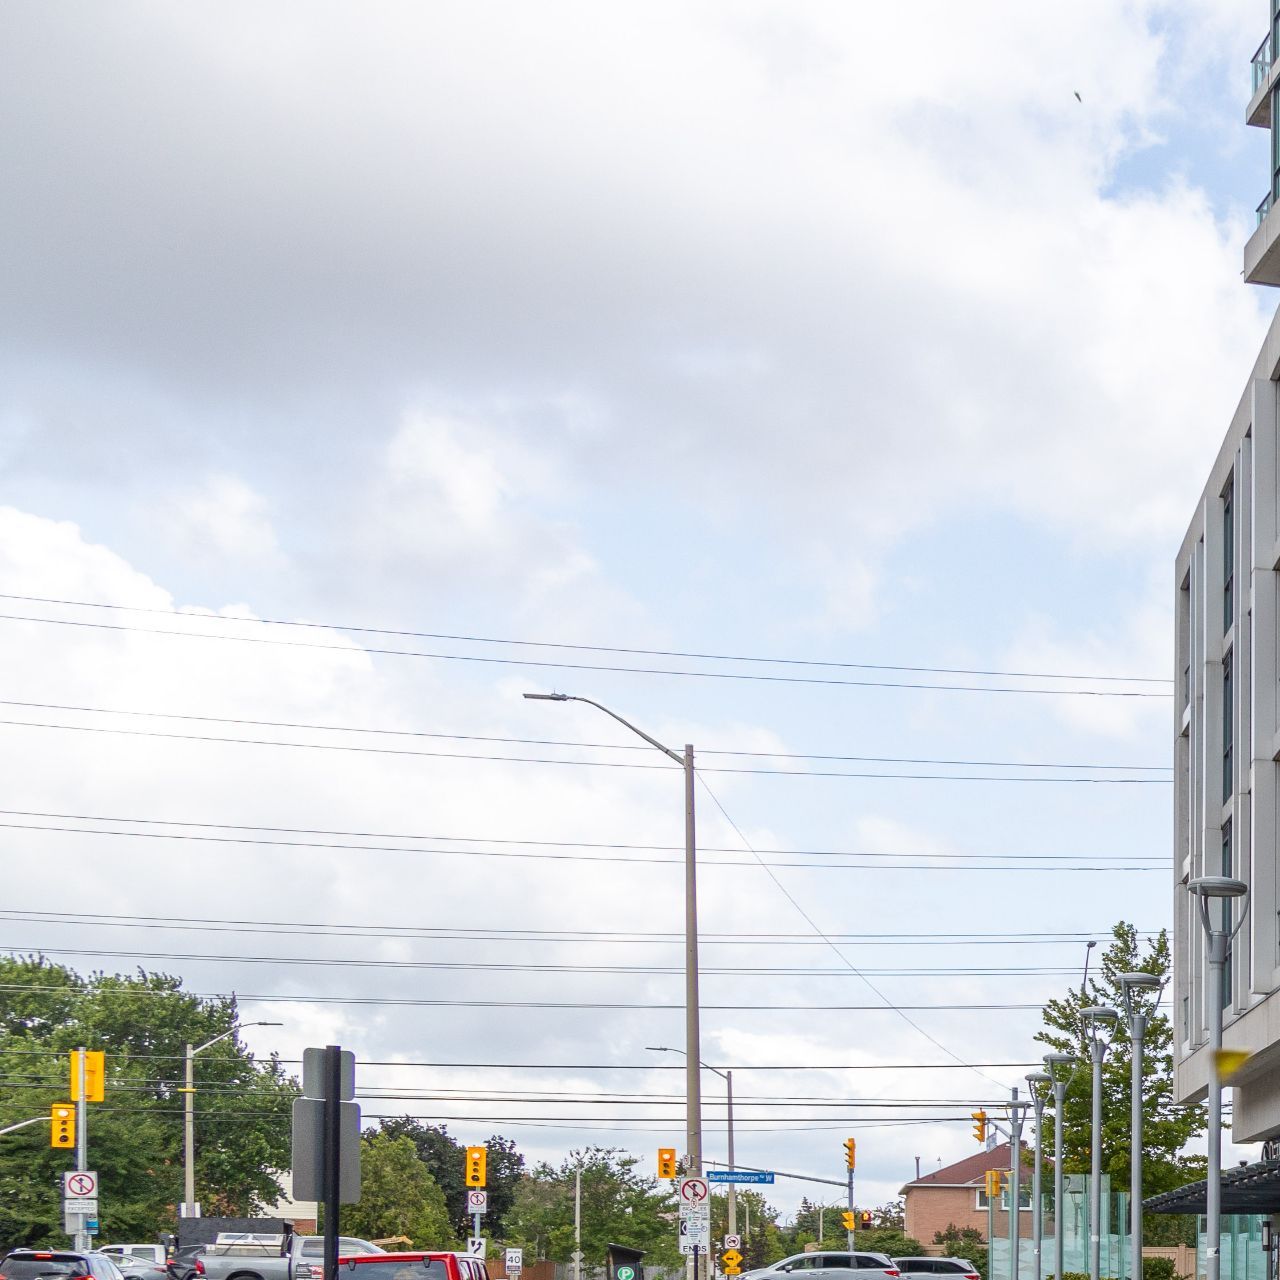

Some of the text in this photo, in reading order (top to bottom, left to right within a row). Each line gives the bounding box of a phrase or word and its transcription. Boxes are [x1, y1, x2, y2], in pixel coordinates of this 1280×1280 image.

[709, 1173, 759, 1182] Burnhamthorpe
[507, 1255, 521, 1264] 40
[622, 1268, 632, 1280] P
